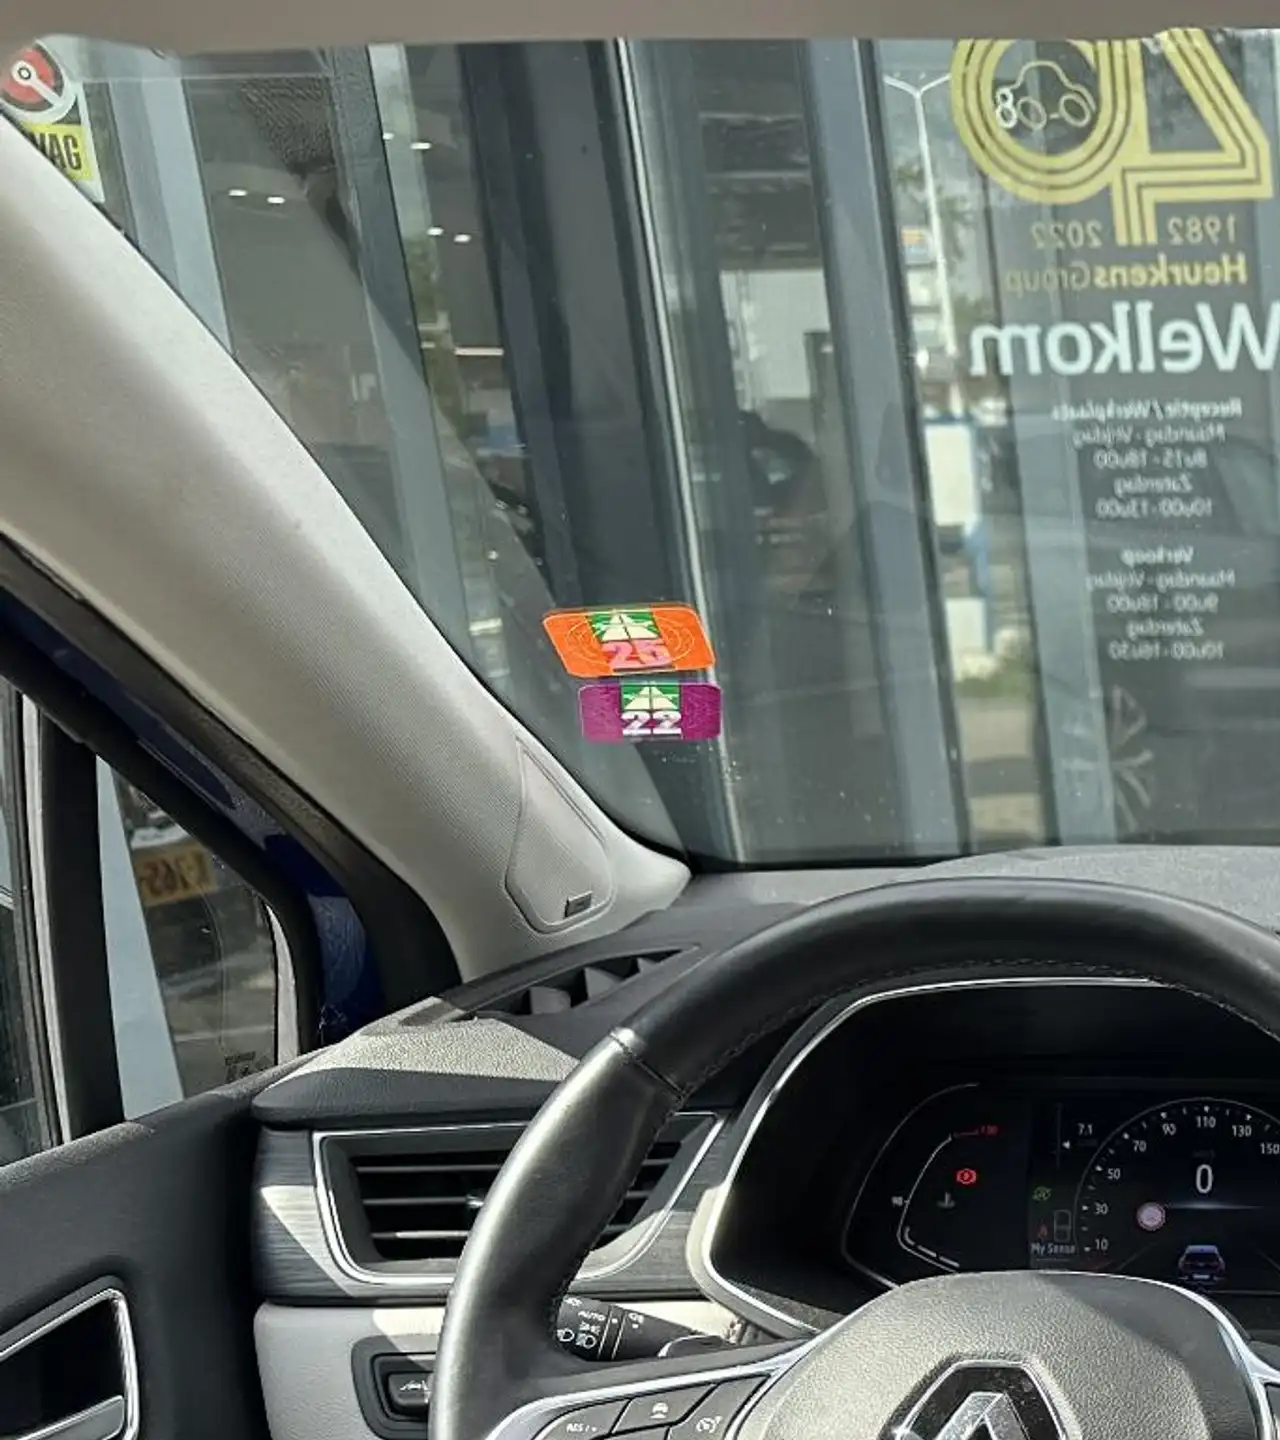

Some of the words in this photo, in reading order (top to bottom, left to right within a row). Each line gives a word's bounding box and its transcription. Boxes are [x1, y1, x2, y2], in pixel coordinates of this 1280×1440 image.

[621, 711, 682, 735] 22
[1195, 1116, 1217, 1129] 110
[1161, 1123, 1177, 1136] 90
[1232, 1124, 1253, 1137] 130
[1132, 1140, 1147, 1153] 70
[1259, 1142, 1280, 1155] 150
[1107, 1167, 1121, 1180] 50
[1195, 1163, 1214, 1194] 0
[1094, 1202, 1109, 1215] 30
[1095, 1238, 1109, 1251] 10
